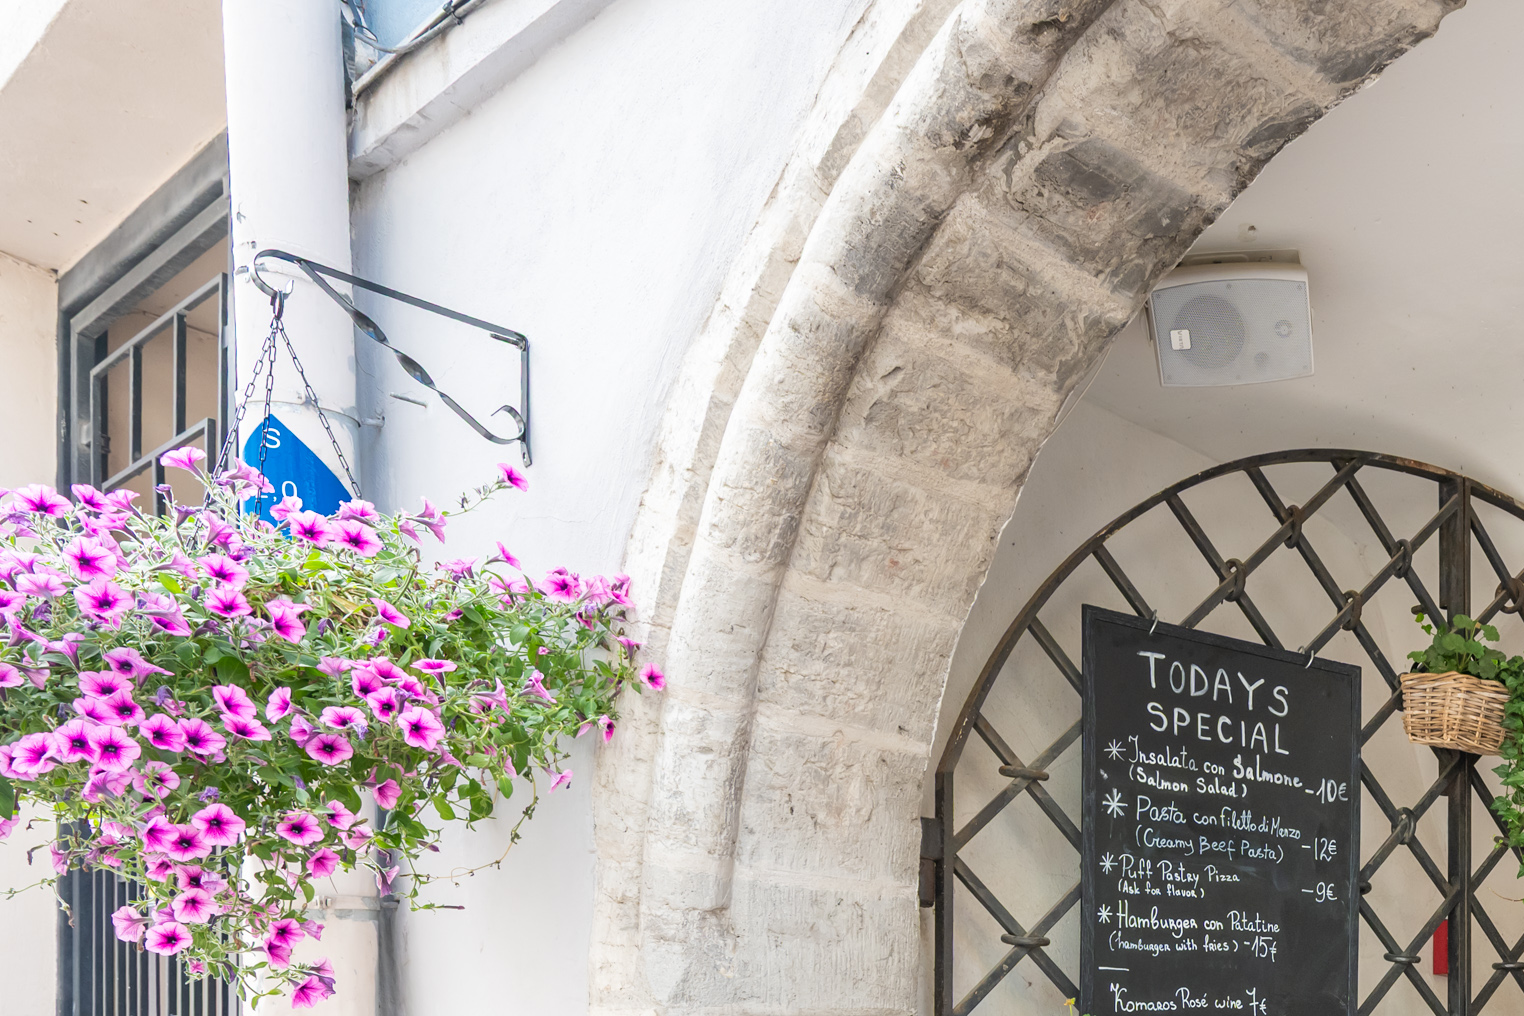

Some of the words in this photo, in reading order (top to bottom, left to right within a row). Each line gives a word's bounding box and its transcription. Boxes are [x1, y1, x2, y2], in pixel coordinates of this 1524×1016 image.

[263, 428, 281, 449] S
[1137, 651, 1290, 717] TODAYS
[1147, 702, 1290, 755] SPECIAL
[1128, 735, 1199, 773] Insalata
[1203, 760, 1226, 776] con
[1233, 753, 1303, 788] Salmone
[1128, 764, 1189, 793] (Salmon
[1136, 795, 1187, 824] Pasta
[1193, 812, 1218, 826] con
[1258, 816, 1269, 833] di
[1135, 824, 1194, 856] (Creamy
[1199, 836, 1236, 861] Beef
[1240, 840, 1284, 864] Pasta)
[1119, 853, 1153, 879] Puff
[1157, 860, 1200, 889] Pastry
[1203, 864, 1241, 882] Pizza
[1145, 883, 1162, 896] for
[1116, 899, 1198, 938] Hamburger
[1203, 917, 1224, 931] con
[1227, 910, 1280, 934] Patatine
[1175, 937, 1198, 952] with
[1175, 987, 1209, 1009] Rosé
[1214, 997, 1243, 1010] wine
